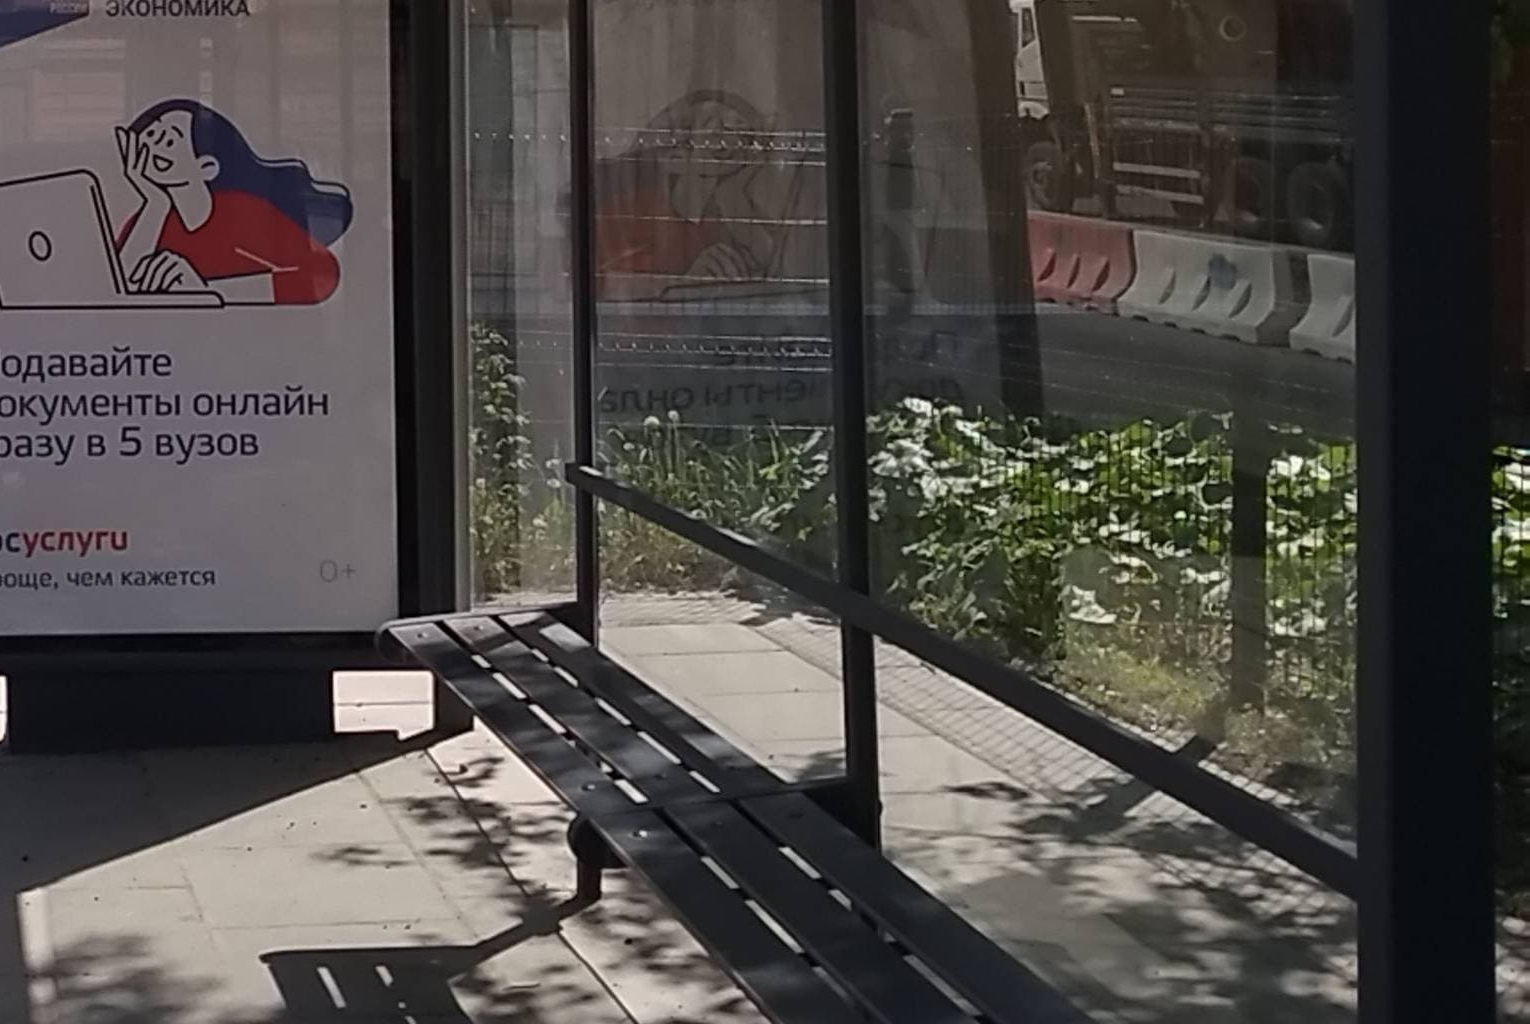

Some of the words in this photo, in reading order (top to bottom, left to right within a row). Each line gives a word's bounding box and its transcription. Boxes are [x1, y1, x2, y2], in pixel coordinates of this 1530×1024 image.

[192, 385, 329, 417] онлайн
[86, 434, 107, 457] в
[120, 427, 142, 457] 5
[155, 432, 260, 465] вузов
[67, 570, 114, 588] чем
[120, 567, 216, 587] кажется
[318, 559, 357, 583] 0+
